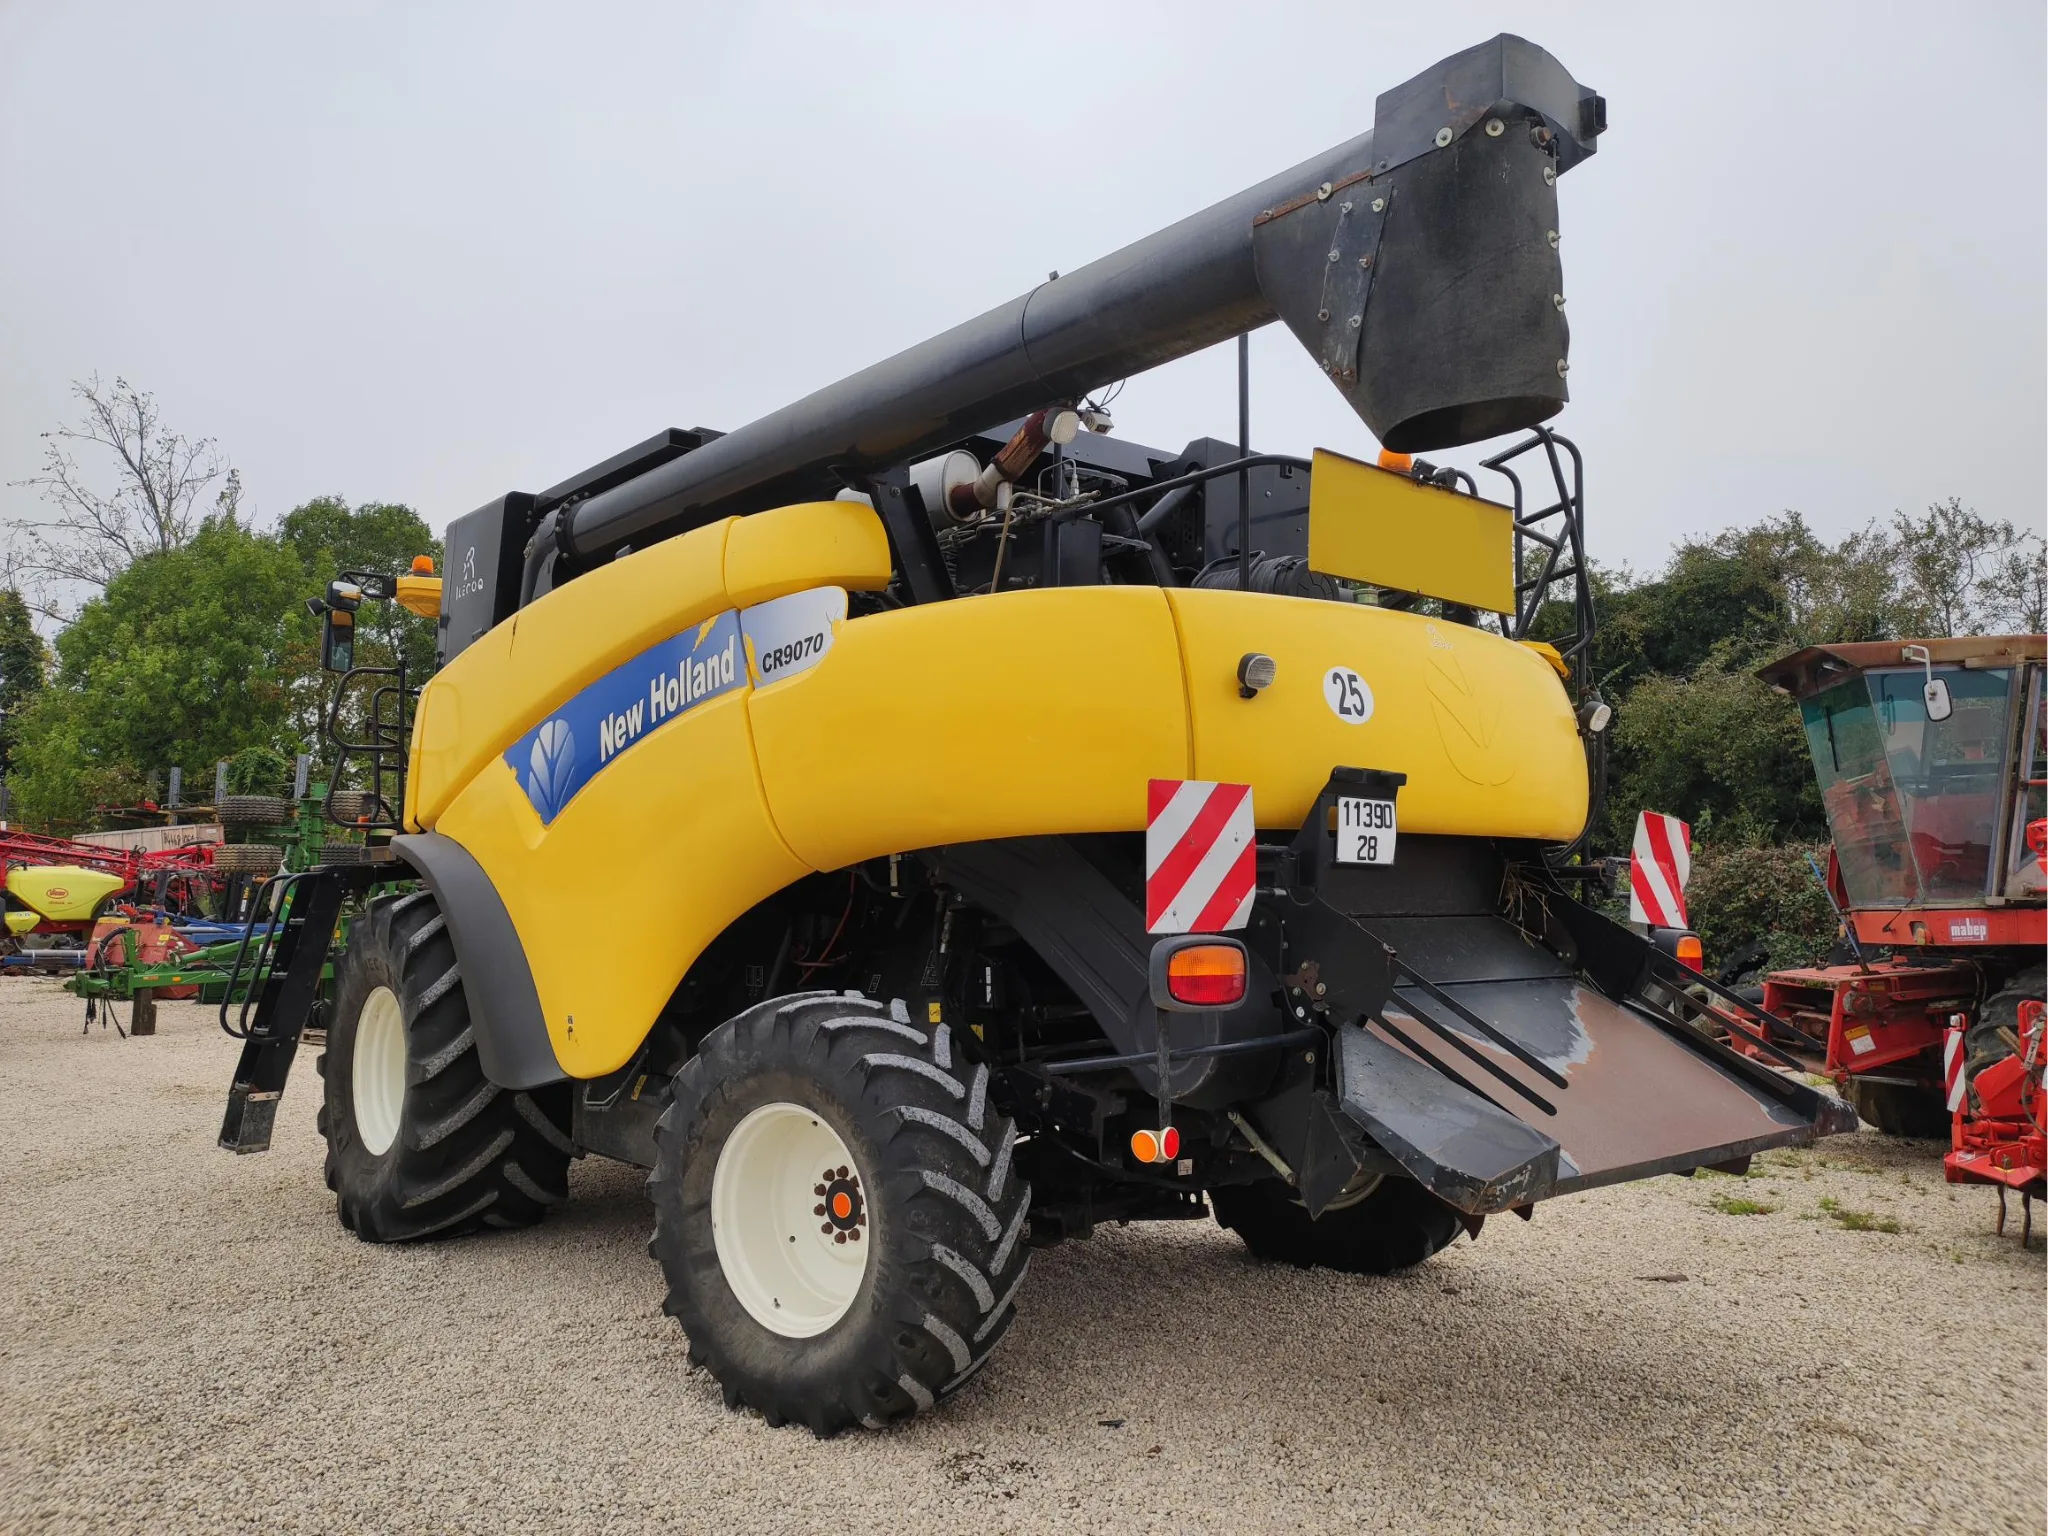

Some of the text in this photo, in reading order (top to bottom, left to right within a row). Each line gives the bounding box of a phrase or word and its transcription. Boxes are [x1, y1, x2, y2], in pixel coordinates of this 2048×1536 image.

[762, 632, 824, 673] CR9070
[600, 634, 735, 763] New Holland
[1332, 672, 1365, 717] 25
[1343, 801, 1393, 829] 11390
[1357, 835, 1378, 861] 28
[1951, 918, 1986, 940] mabep
